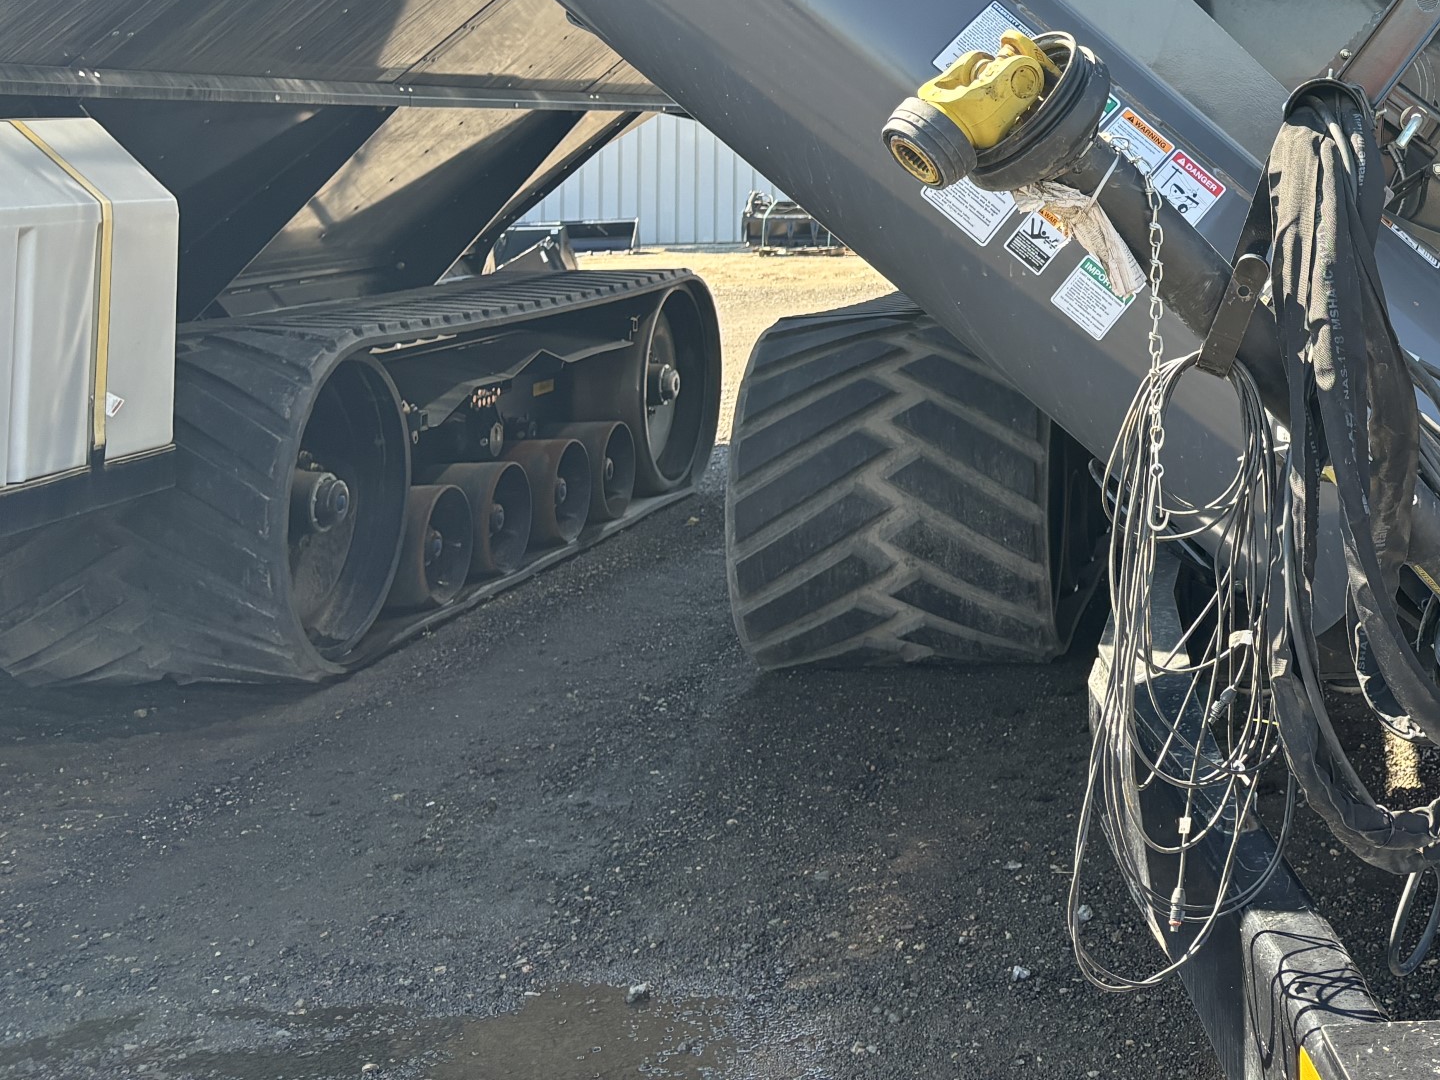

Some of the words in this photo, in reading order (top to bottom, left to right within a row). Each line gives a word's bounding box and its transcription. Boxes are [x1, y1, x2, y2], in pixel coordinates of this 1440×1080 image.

[1134, 120, 1166, 149] WARNING
[1184, 162, 1217, 191] DANGER
[1326, 288, 1341, 329] MSHA
[1334, 335, 1349, 399] NAS-178
